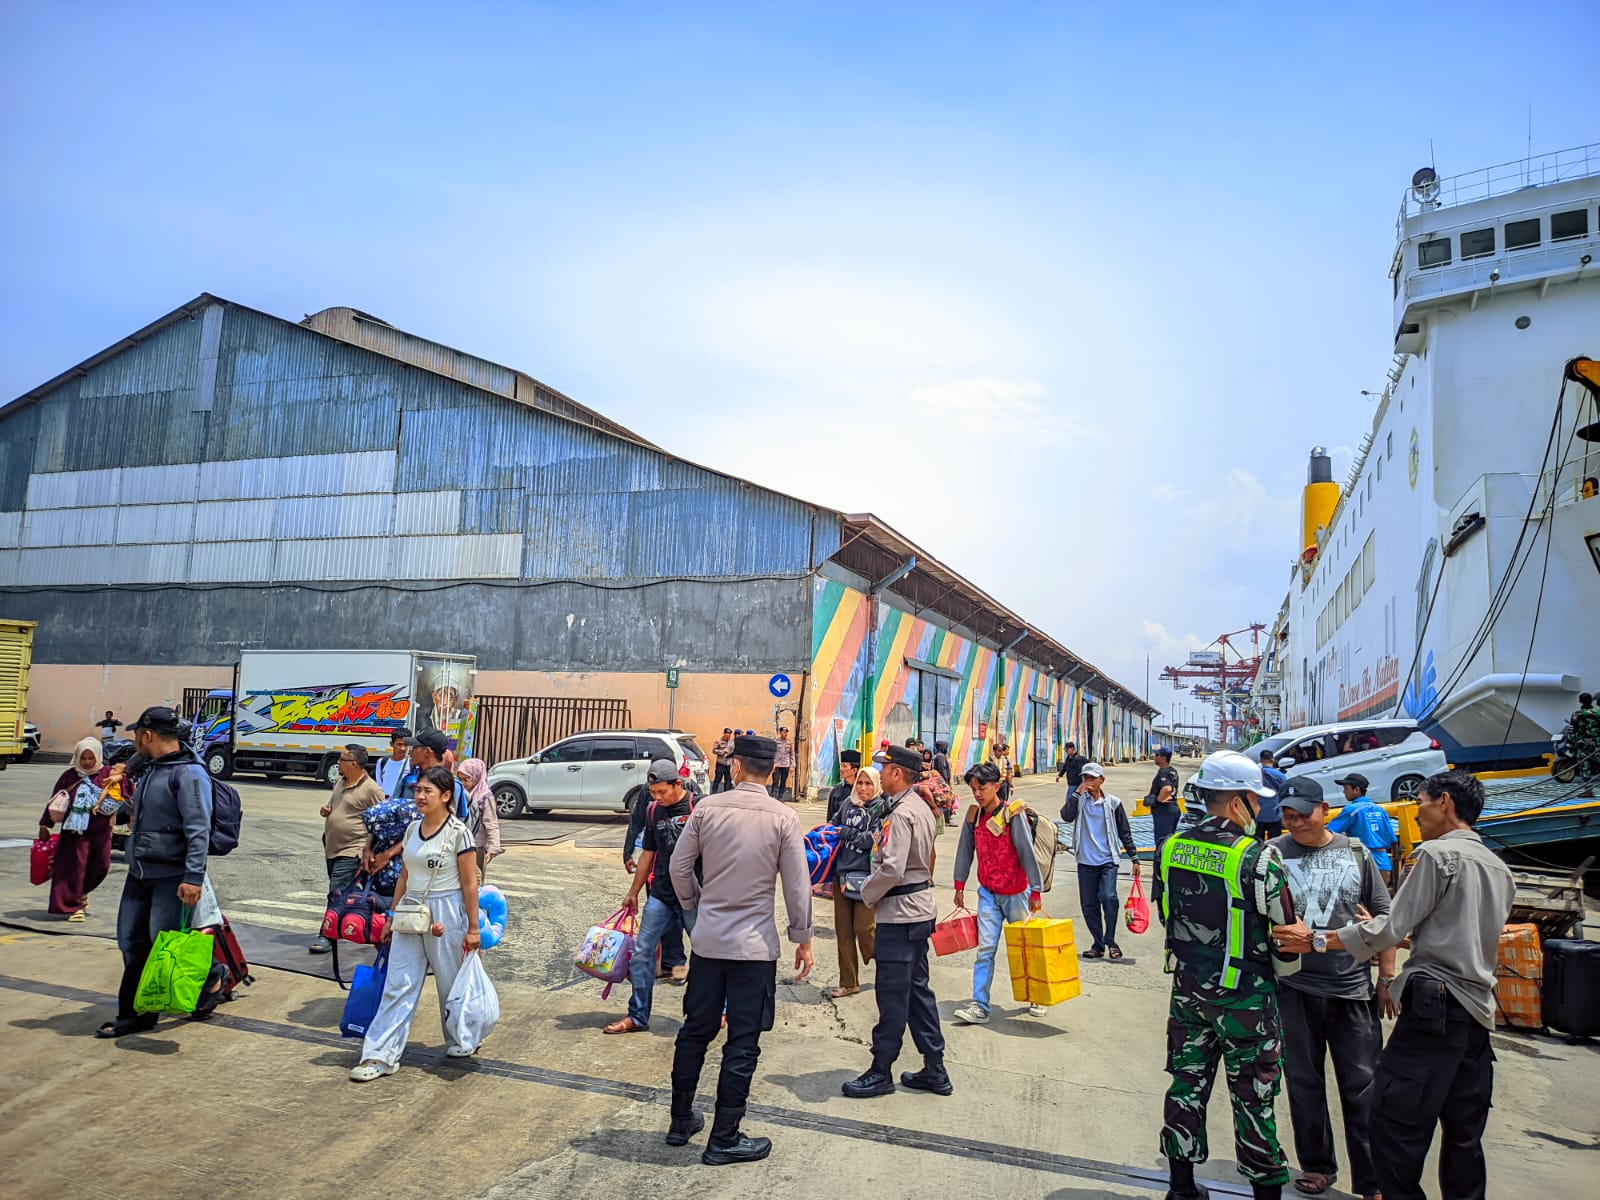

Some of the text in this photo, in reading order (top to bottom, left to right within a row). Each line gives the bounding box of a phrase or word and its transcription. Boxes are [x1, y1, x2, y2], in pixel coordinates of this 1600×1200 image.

[375, 700, 410, 719] 69
[1174, 842, 1227, 862] POLISI
[1170, 851, 1225, 874] MILITER
